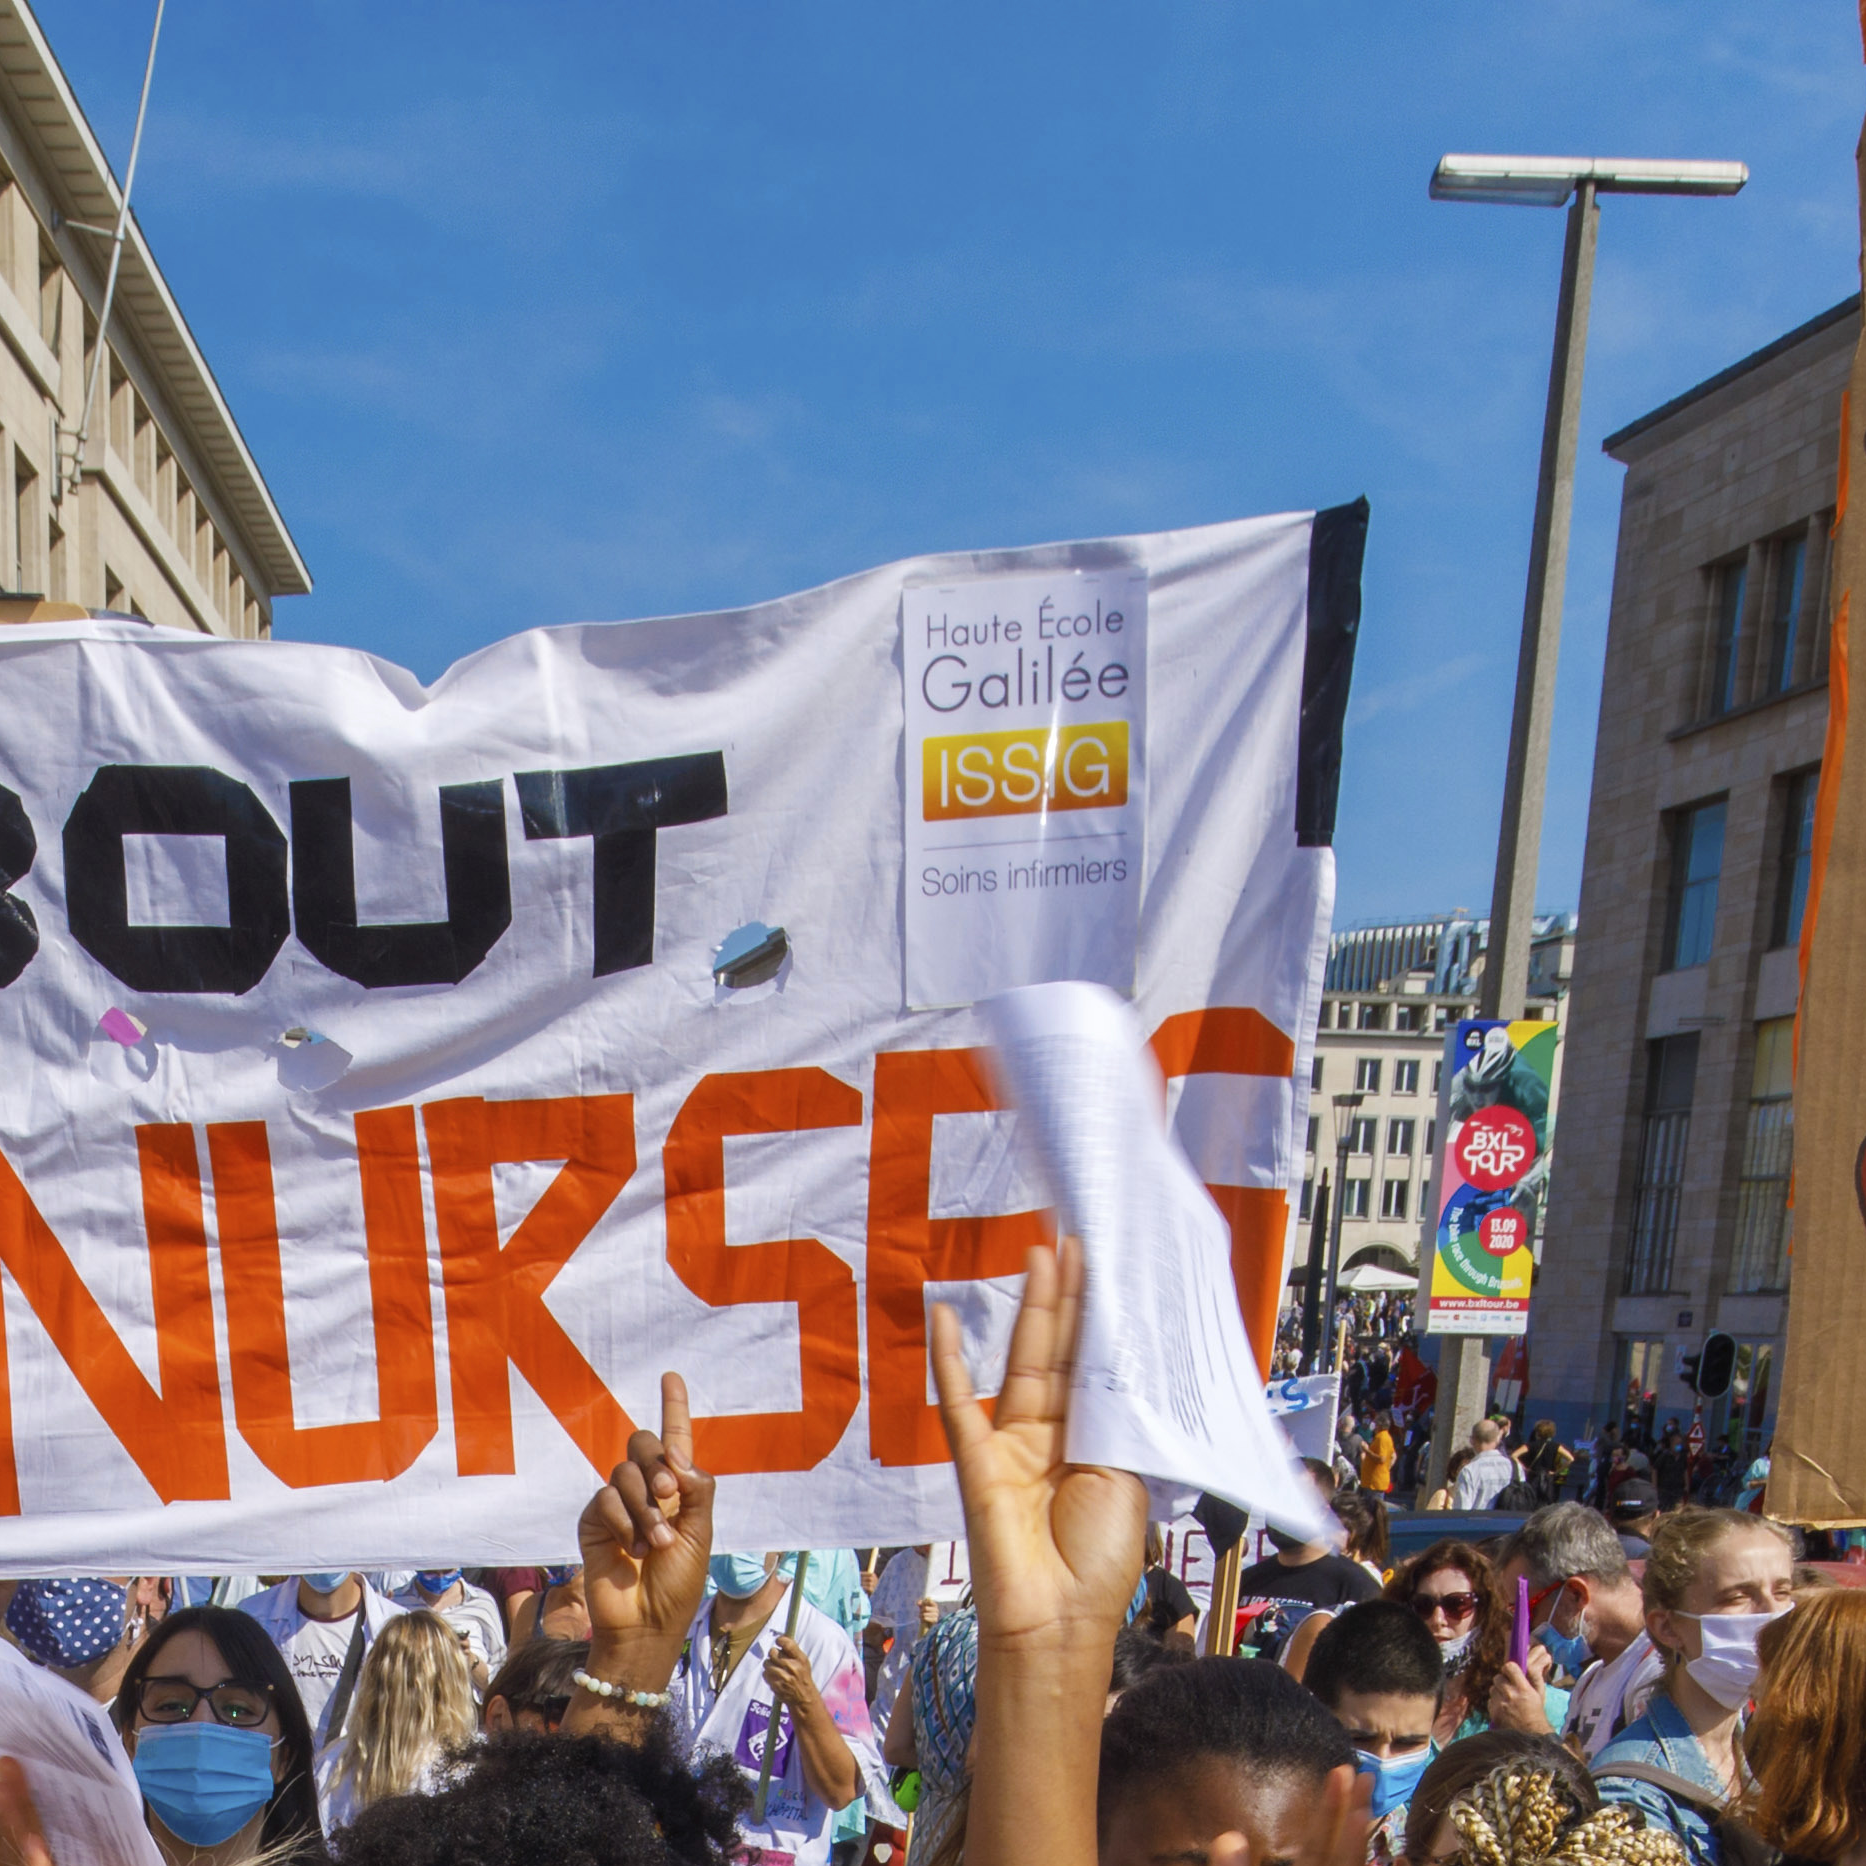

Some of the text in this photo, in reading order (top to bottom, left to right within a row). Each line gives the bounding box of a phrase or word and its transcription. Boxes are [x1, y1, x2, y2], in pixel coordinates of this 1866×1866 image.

[926, 595, 1125, 649] Haute École
[921, 645, 1129, 713] Galilée
[940, 736, 1110, 808] ISSIG
[921, 856, 1128, 897] Soins infirmiers
[1472, 1130, 1511, 1151] BXL
[1465, 1150, 1517, 1176] TOUR
[1488, 1234, 1515, 1249] 2020
[1438, 1298, 1520, 1309] www.bxltour.be
